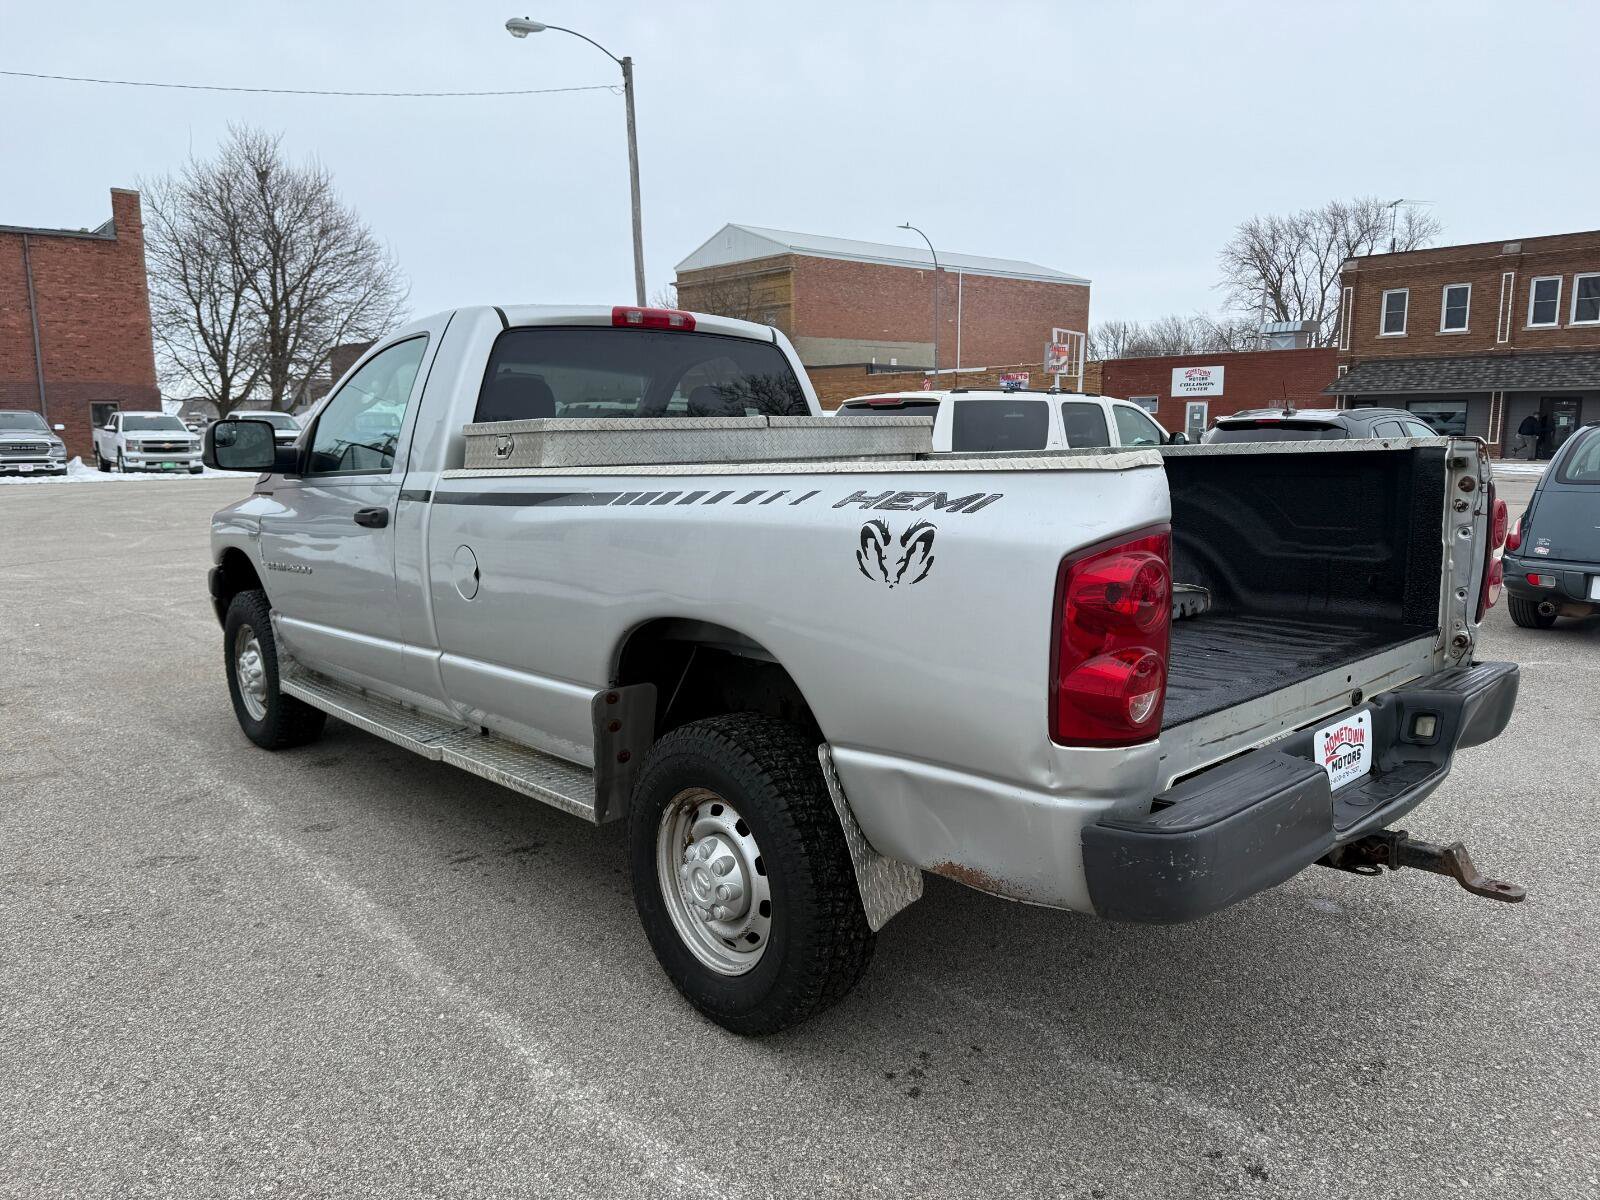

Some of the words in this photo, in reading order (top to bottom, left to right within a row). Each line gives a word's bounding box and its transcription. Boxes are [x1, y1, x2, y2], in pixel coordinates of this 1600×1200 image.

[832, 490, 1004, 514] HEMI
[1324, 727, 1365, 756] HOMETOWN
[1332, 749, 1362, 773] MOTORS
